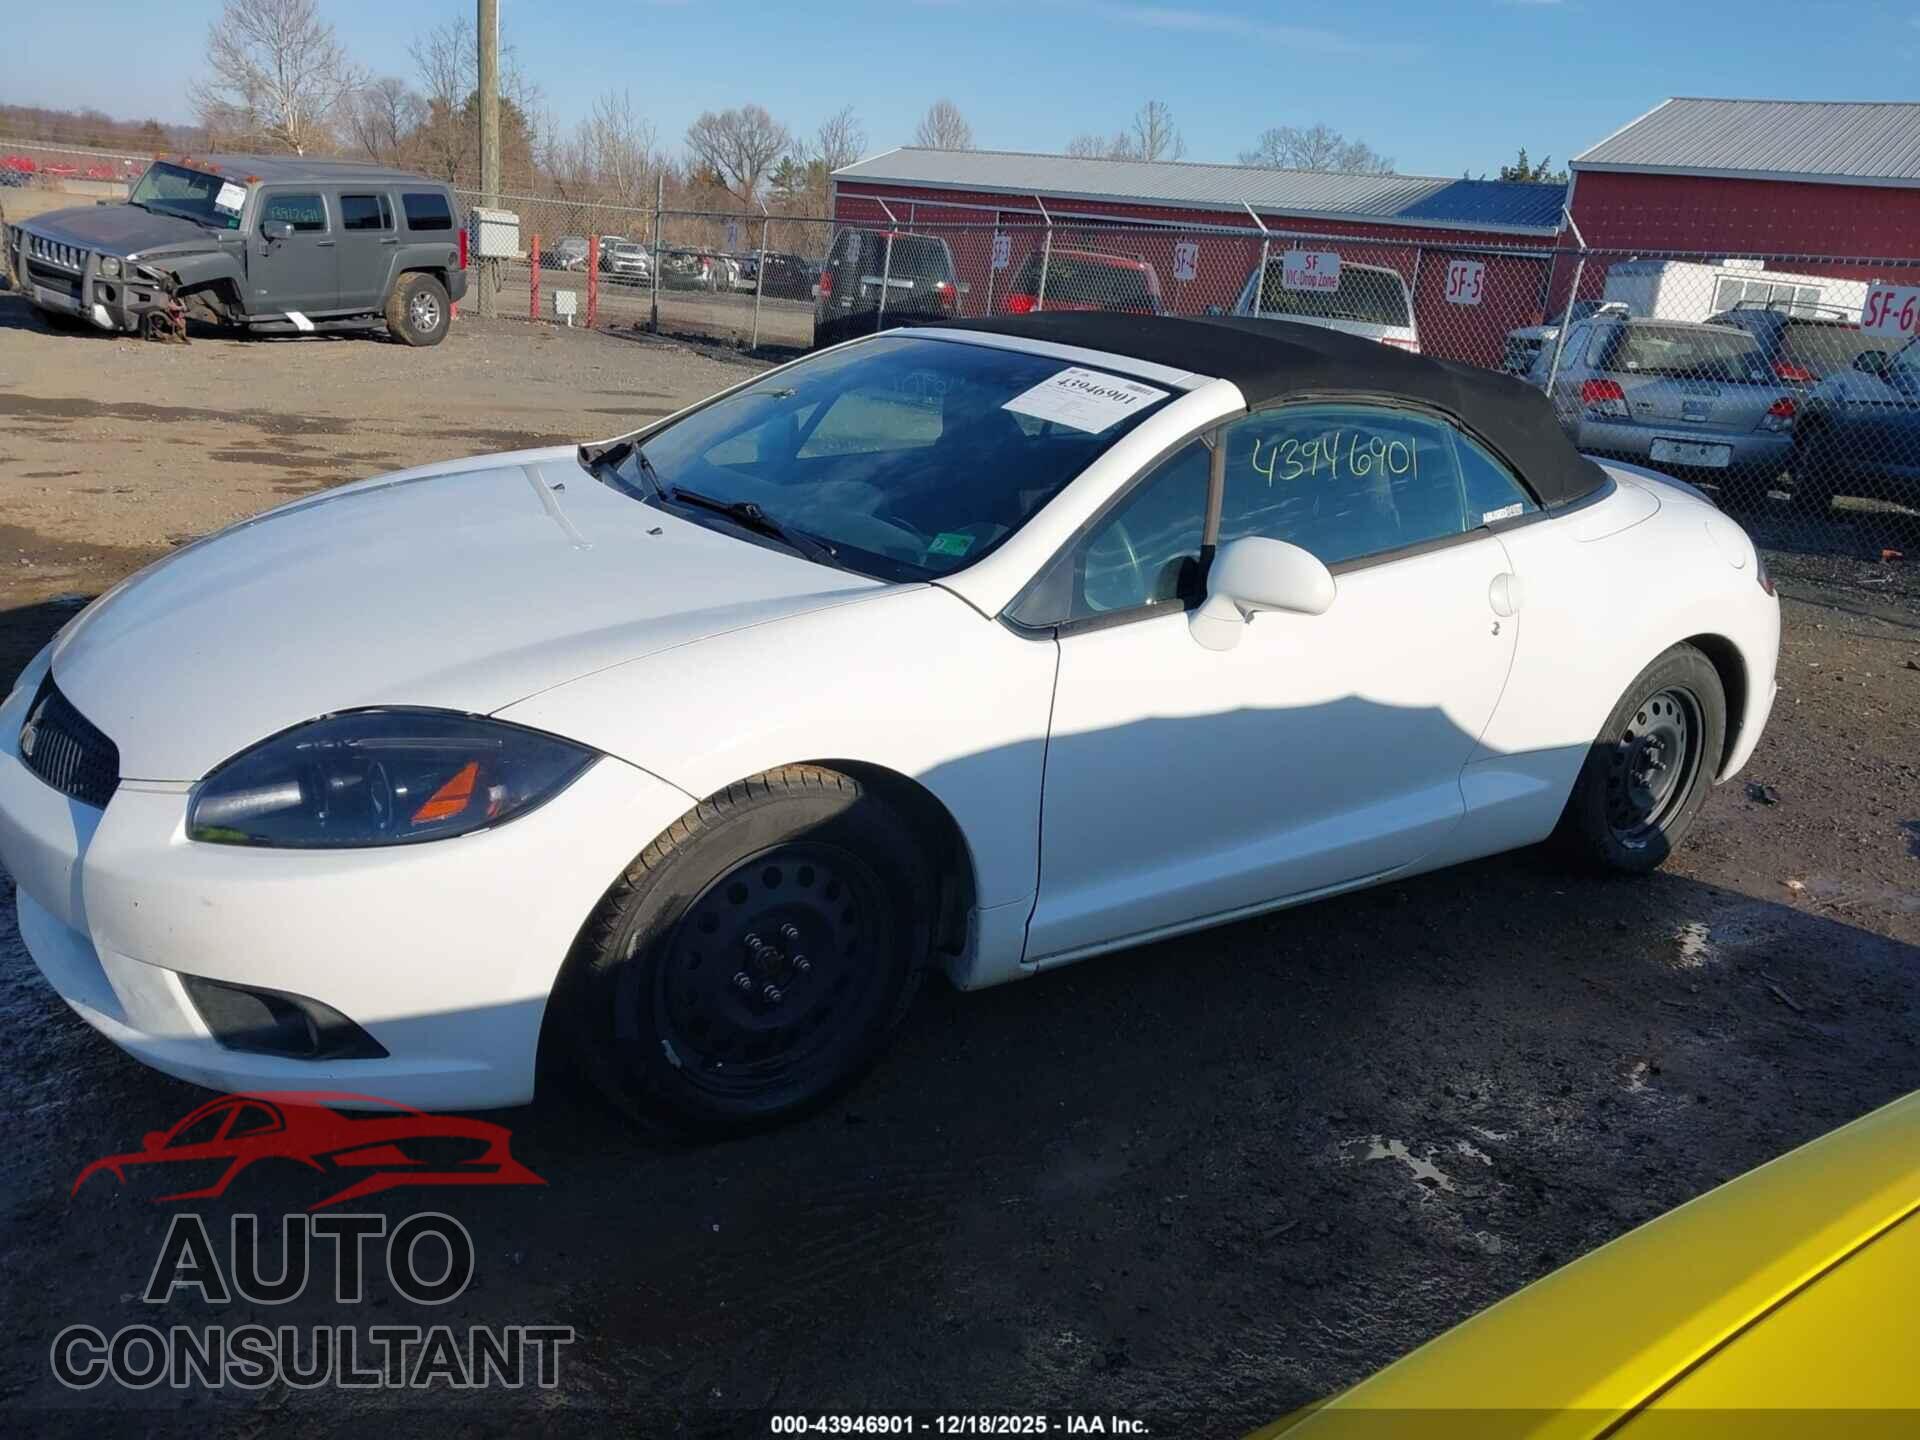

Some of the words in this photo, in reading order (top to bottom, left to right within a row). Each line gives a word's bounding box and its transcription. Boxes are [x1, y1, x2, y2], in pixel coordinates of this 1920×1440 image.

[1305, 254, 1320, 270] SF
[1318, 271, 1338, 289] Zone
[1449, 266, 1482, 298] SF-5
[1864, 291, 1917, 331] SF-6
[1056, 377, 1138, 405] 43946901
[1252, 431, 1418, 489] 43946901
